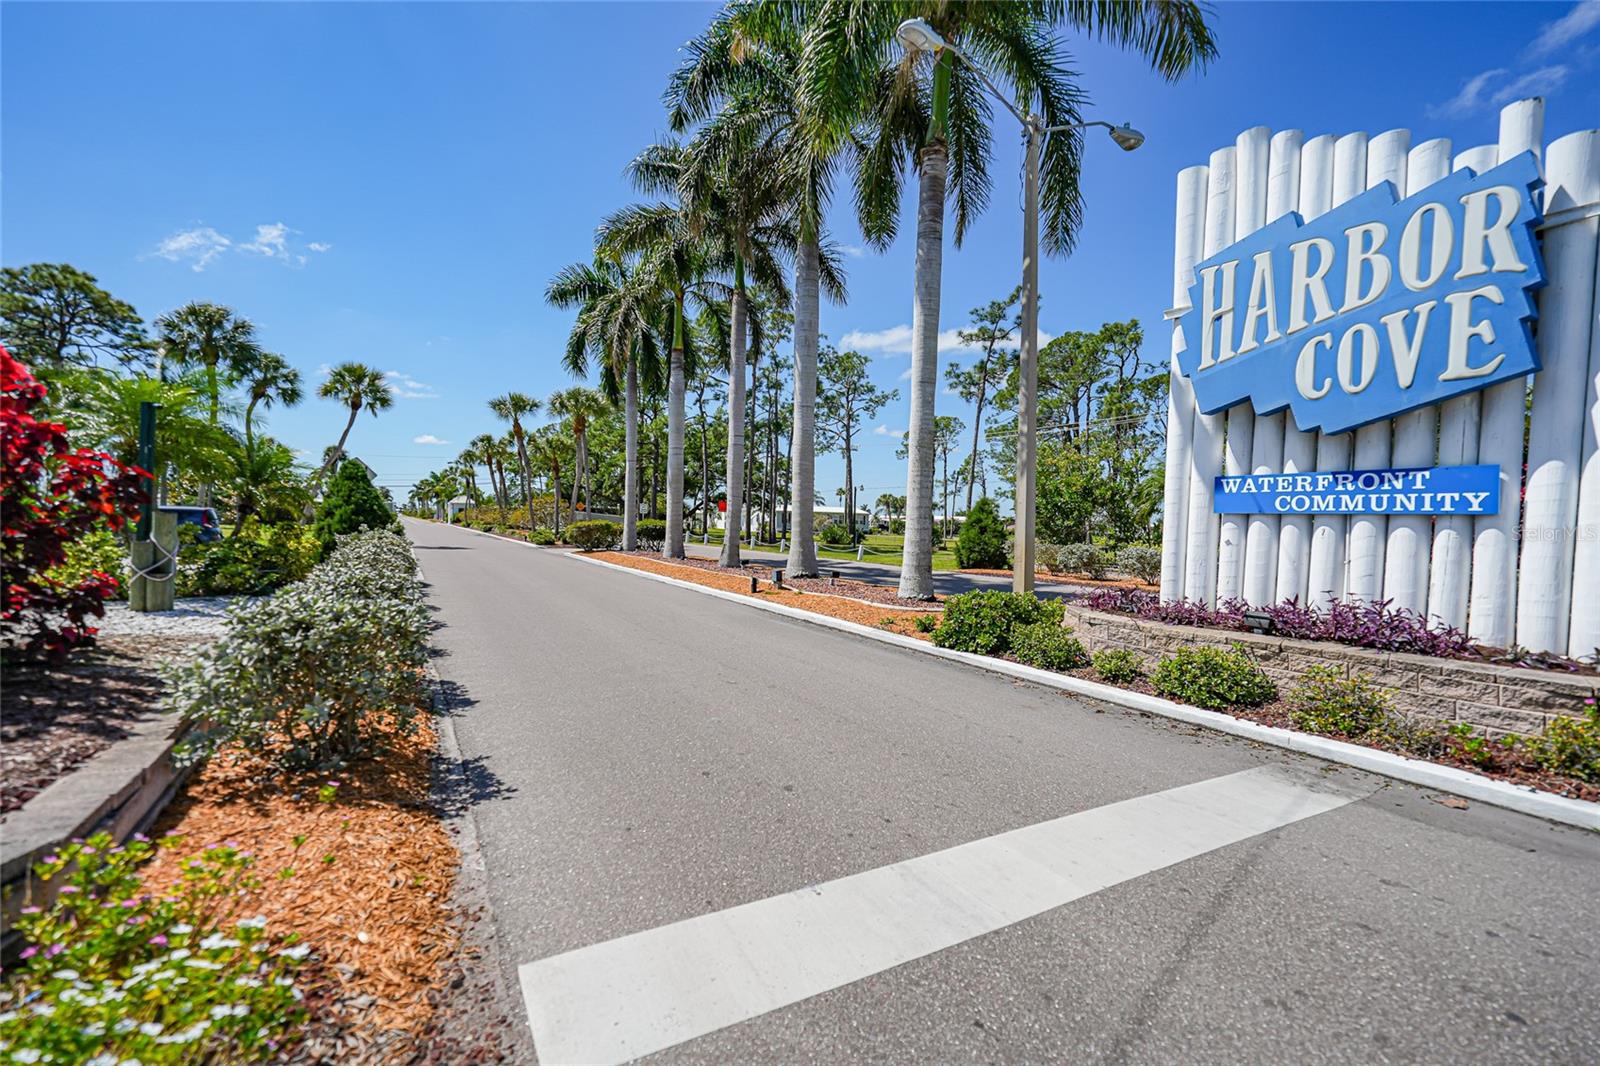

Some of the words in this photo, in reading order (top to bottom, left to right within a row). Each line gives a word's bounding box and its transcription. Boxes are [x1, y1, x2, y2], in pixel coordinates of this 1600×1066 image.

[1197, 184, 1529, 373] HARBOR
[1294, 285, 1507, 401] COVE
[1220, 470, 1431, 494] WATERFRONT
[1274, 491, 1491, 513] COMMUNITY
